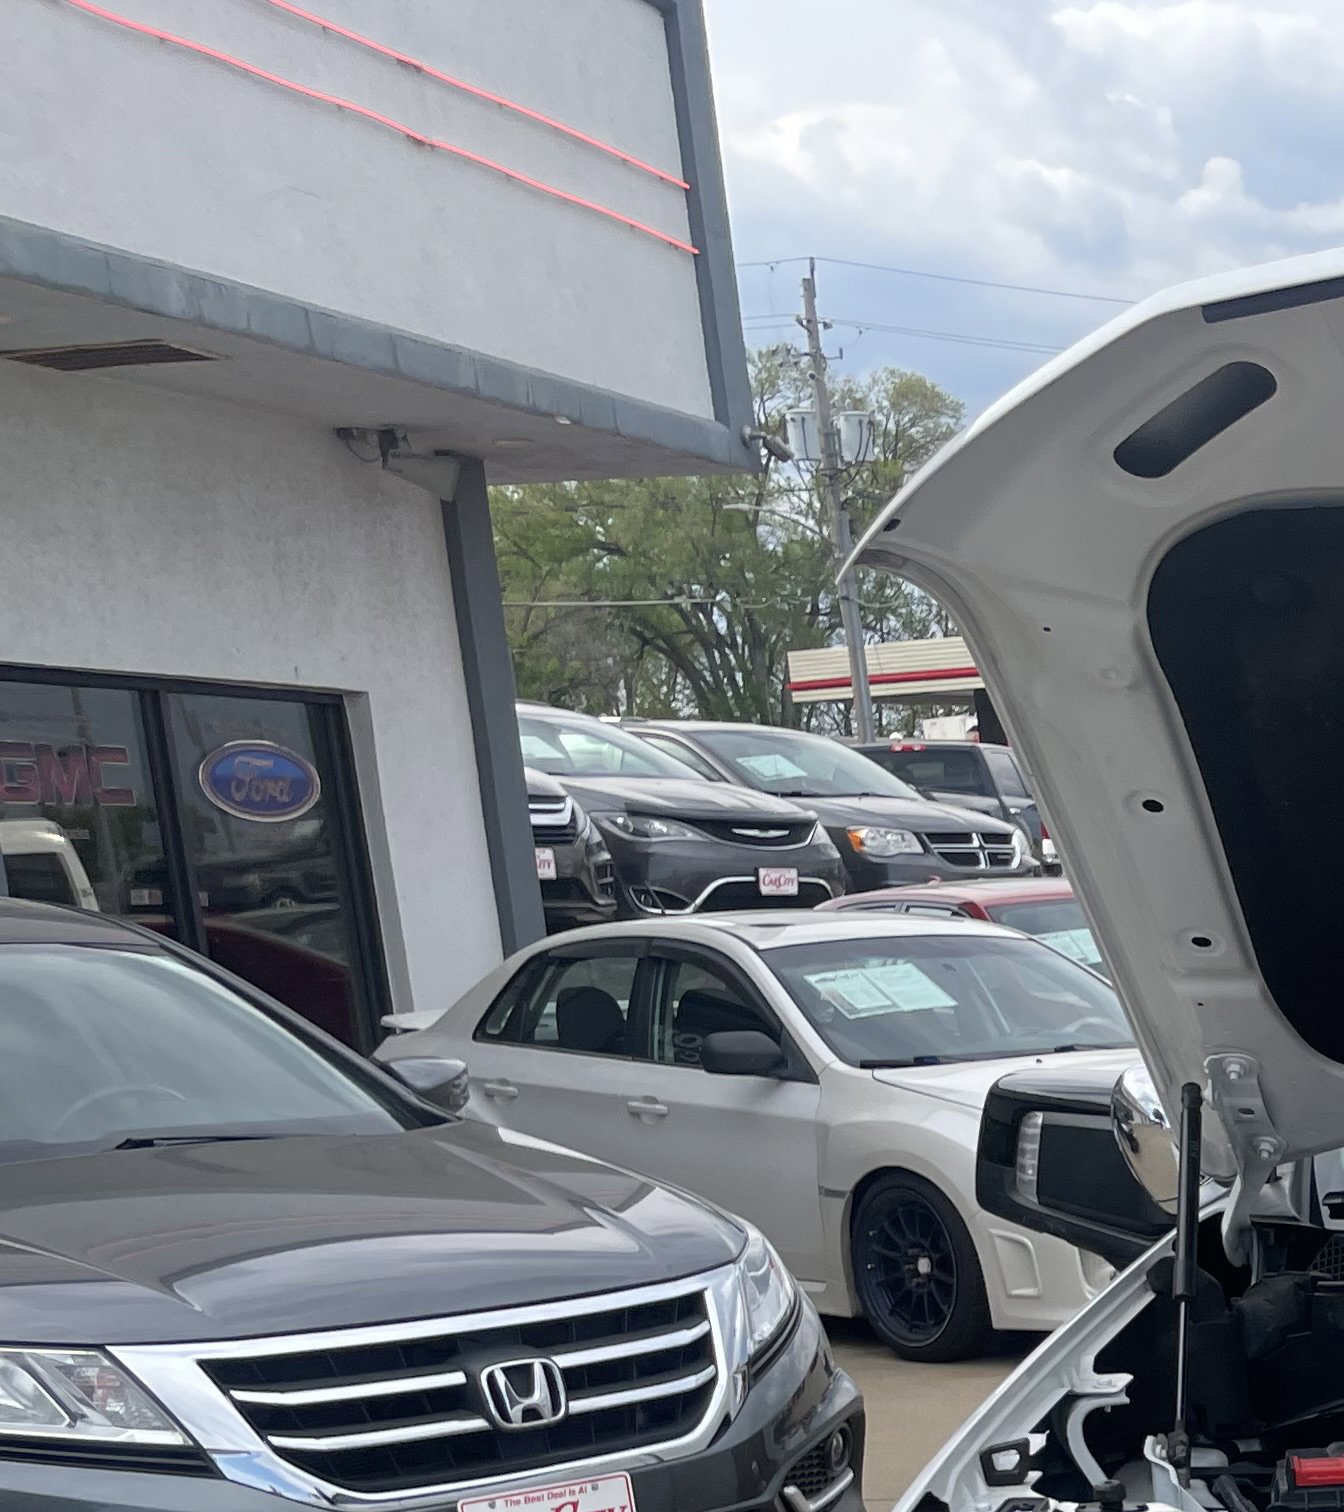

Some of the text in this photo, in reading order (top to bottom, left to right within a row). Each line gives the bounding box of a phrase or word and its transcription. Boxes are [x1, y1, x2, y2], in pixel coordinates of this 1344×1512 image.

[504, 1499, 522, 1508] The
[524, 1494, 545, 1505] Best
[547, 1489, 567, 1500] Deal
